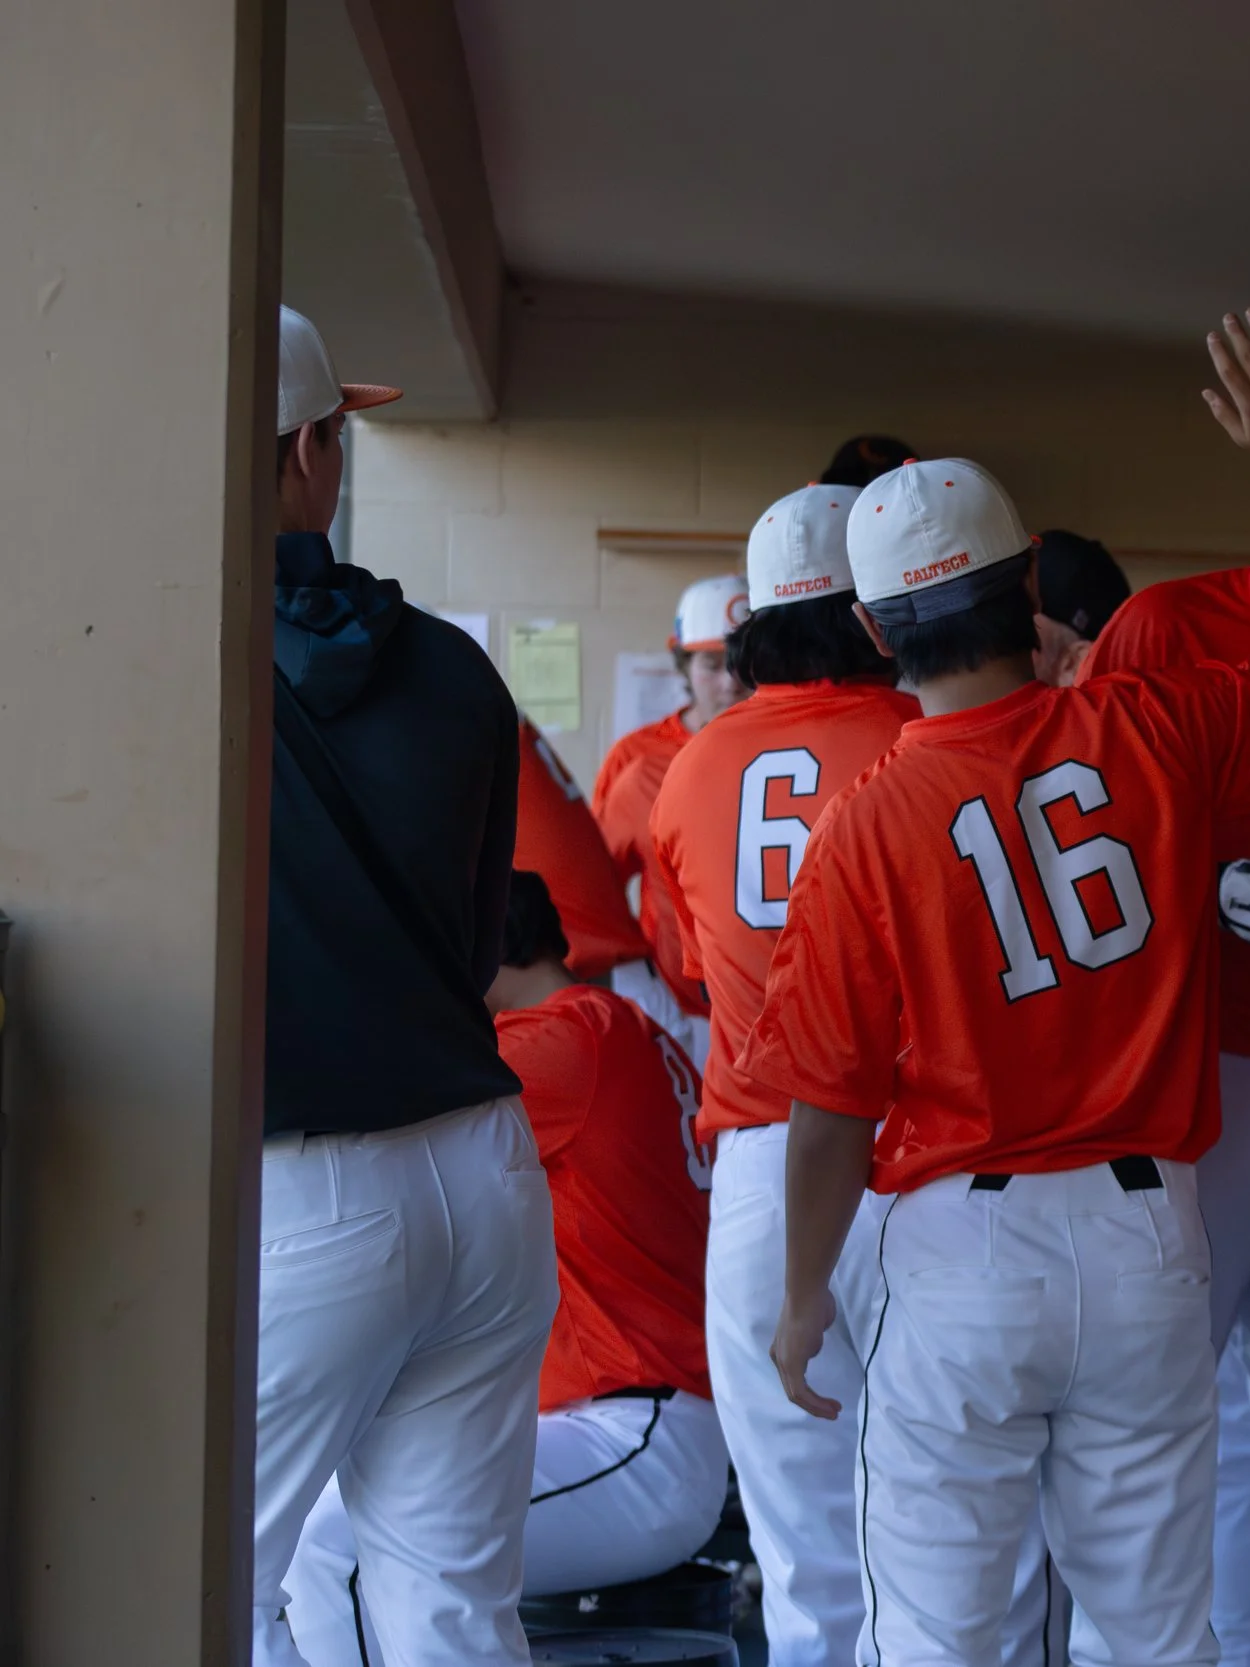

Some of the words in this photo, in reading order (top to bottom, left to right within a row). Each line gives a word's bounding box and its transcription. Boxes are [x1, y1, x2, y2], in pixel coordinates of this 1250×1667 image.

[774, 575, 833, 597] CALTECH
[903, 551, 971, 586] CALTECH
[734, 747, 821, 931] 6
[949, 759, 1155, 1001] 16
